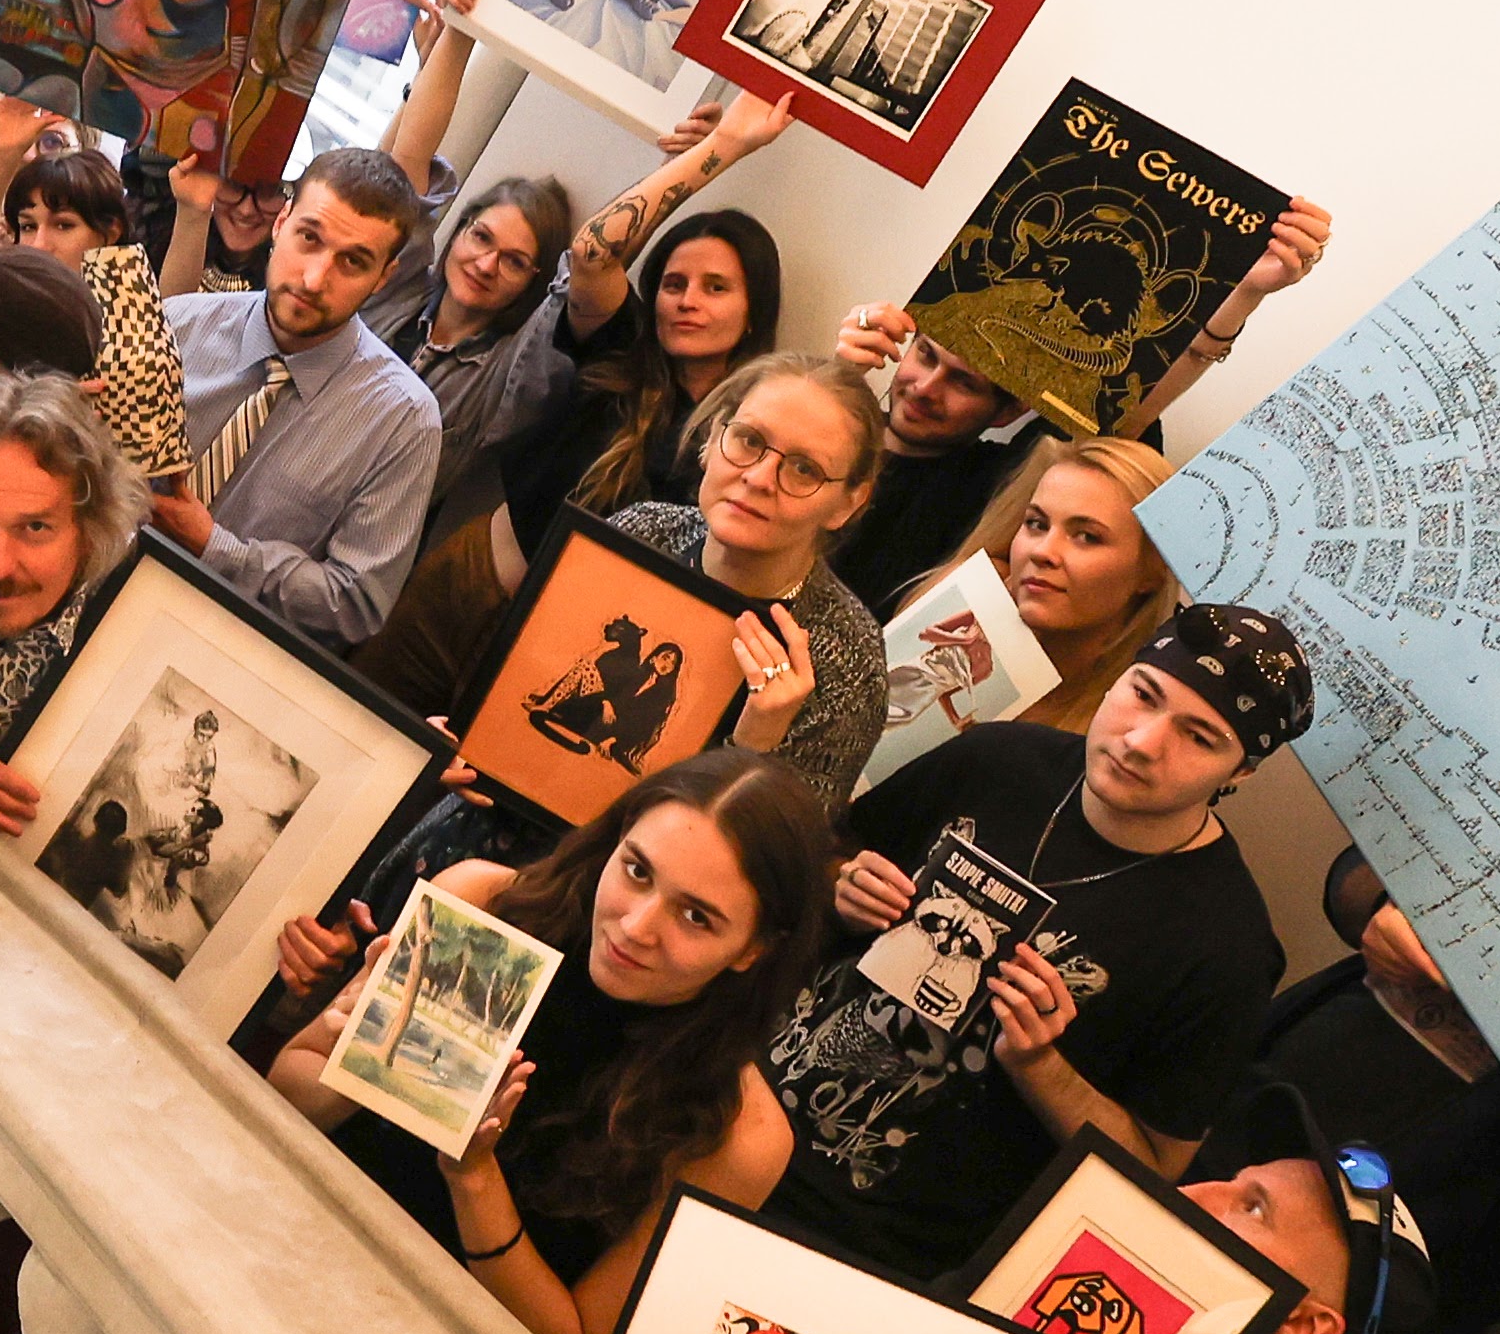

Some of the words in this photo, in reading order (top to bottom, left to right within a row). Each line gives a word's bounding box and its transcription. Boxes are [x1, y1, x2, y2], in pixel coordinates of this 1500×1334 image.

[1062, 104, 1130, 159] The
[1137, 149, 1267, 236] Sewers
[945, 851, 987, 889] SZOPIE
[981, 876, 1029, 916] SMUTKI
